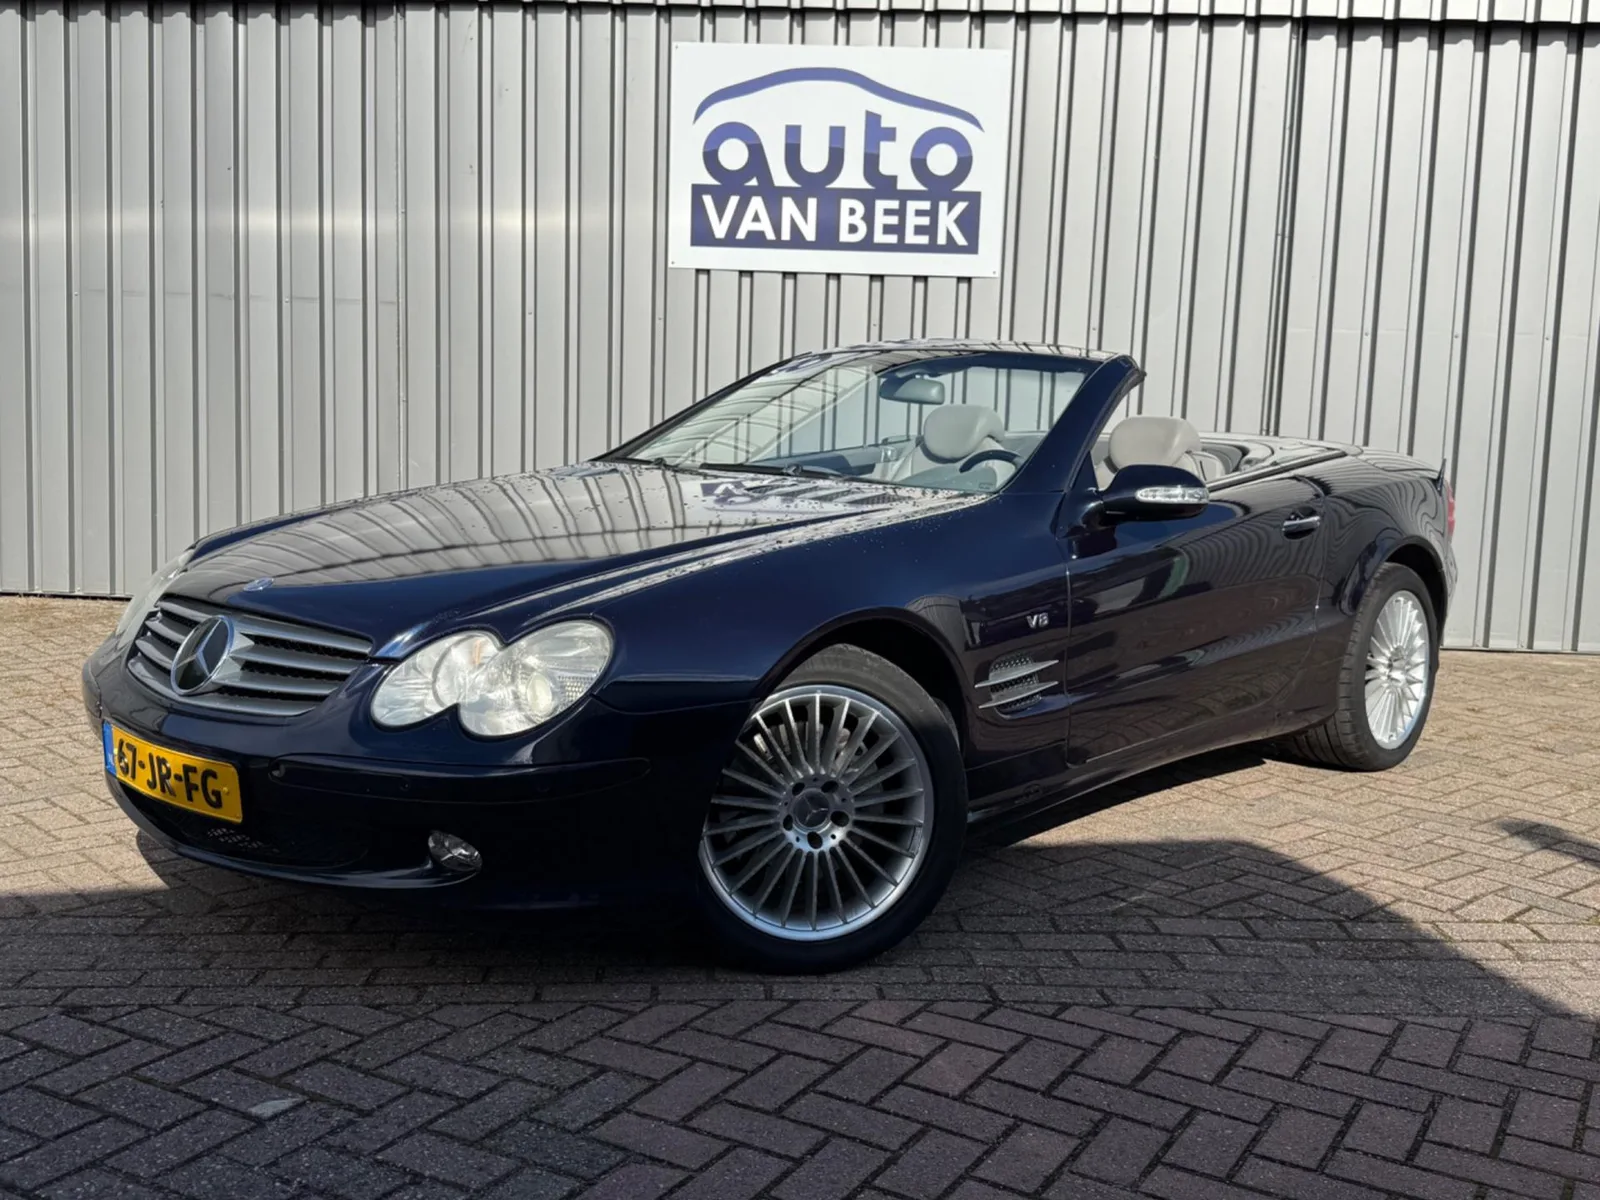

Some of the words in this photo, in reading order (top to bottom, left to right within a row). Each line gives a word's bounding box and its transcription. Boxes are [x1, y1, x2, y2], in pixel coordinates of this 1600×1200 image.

[702, 110, 973, 191] auto
[702, 194, 818, 242] VAN
[839, 198, 970, 246] BEEK
[117, 738, 223, 809] 67-JR-FG
